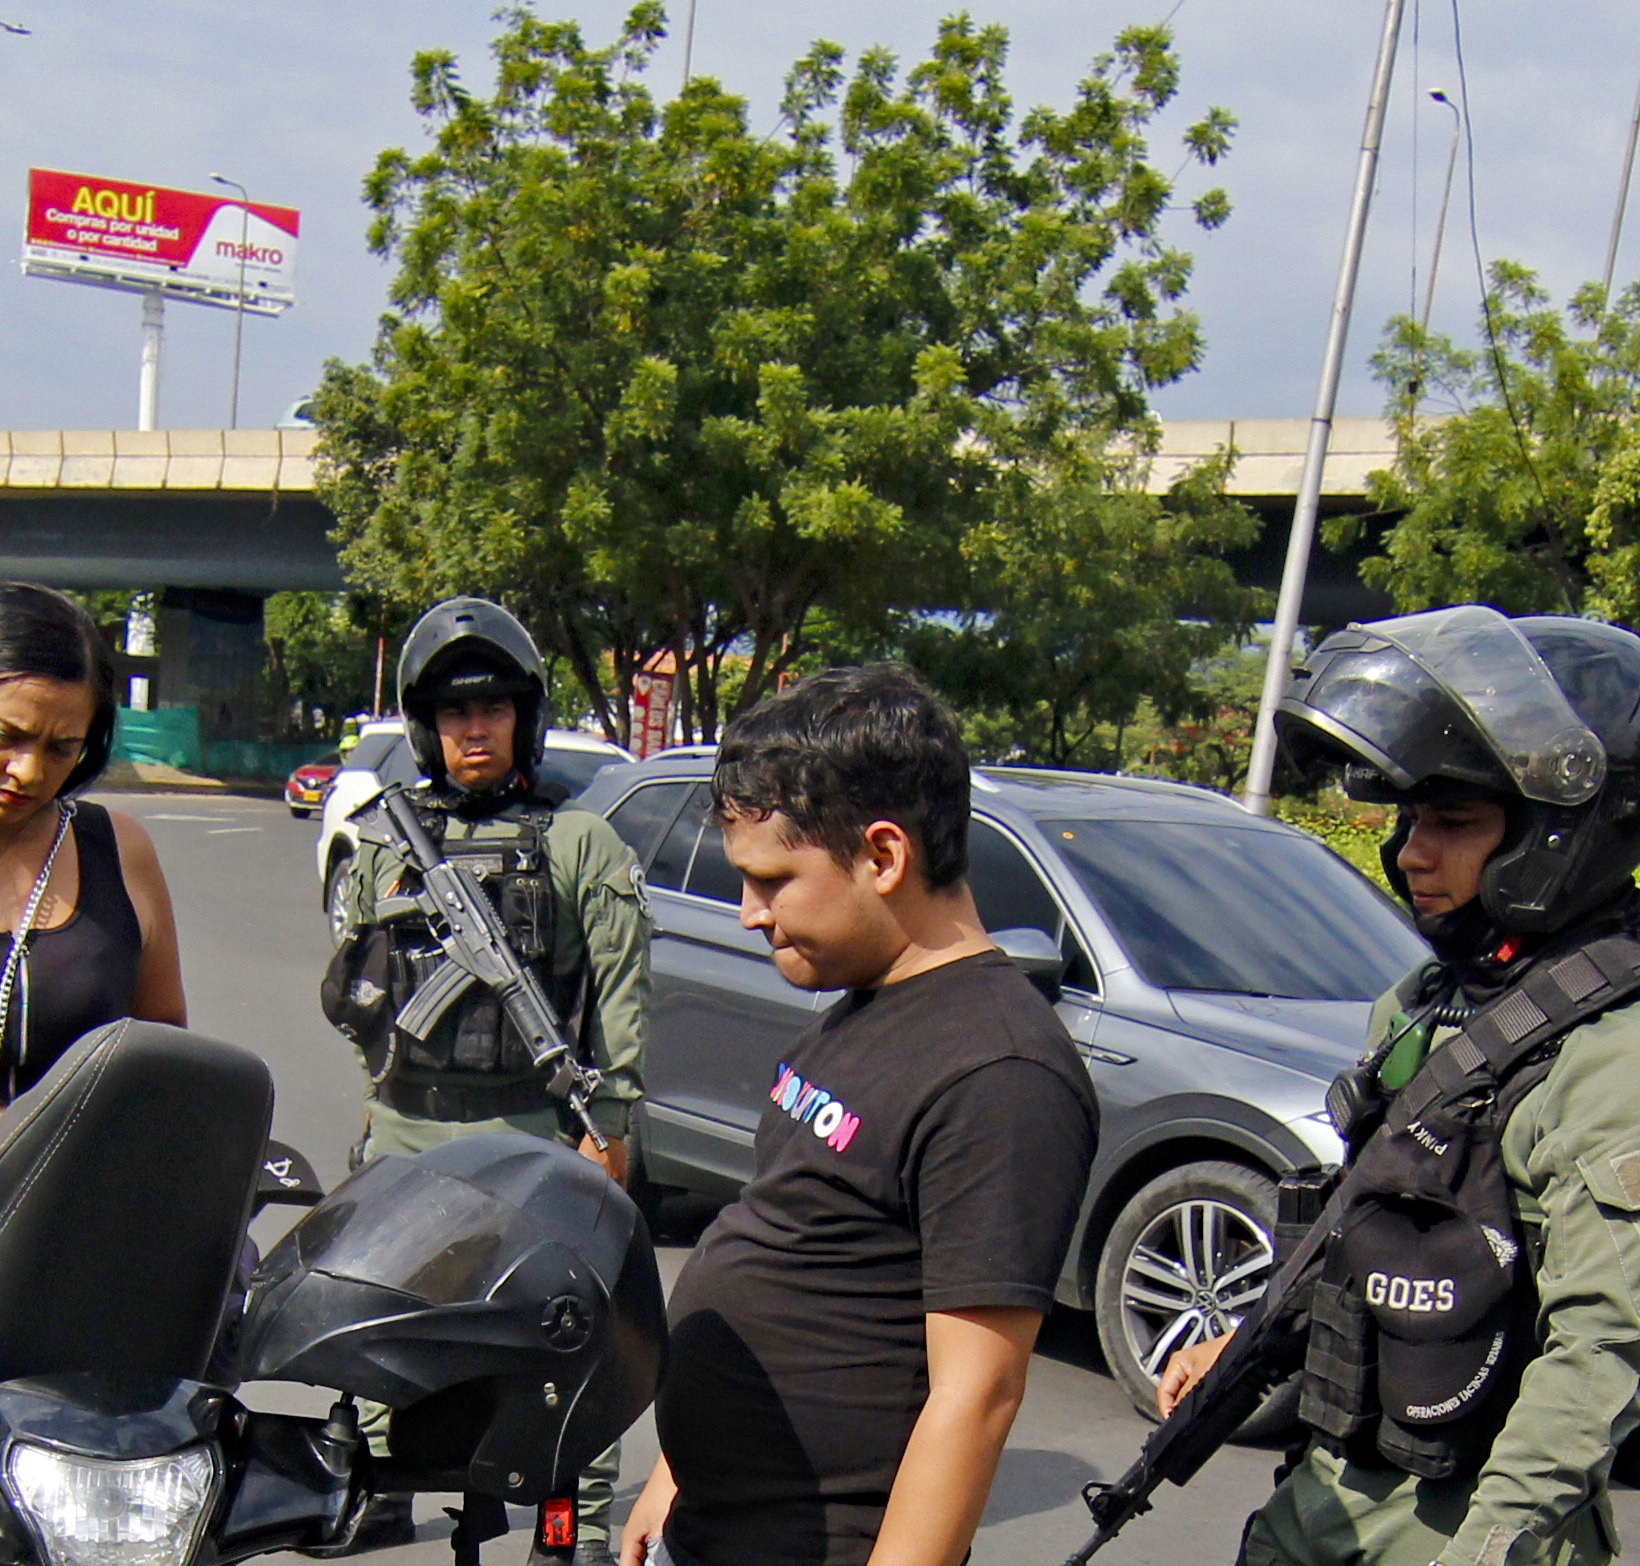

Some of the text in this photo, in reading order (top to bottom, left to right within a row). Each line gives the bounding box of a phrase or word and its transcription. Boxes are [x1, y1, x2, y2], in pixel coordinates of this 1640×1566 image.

[71, 186, 157, 224] AQUÍ
[45, 207, 180, 241] Compras por unidad
[78, 229, 101, 246] por
[102, 232, 158, 252] cantidad
[215, 240, 284, 266] makro
[1406, 1120, 1449, 1156] PINKY
[1366, 1271, 1455, 1313] GOES
